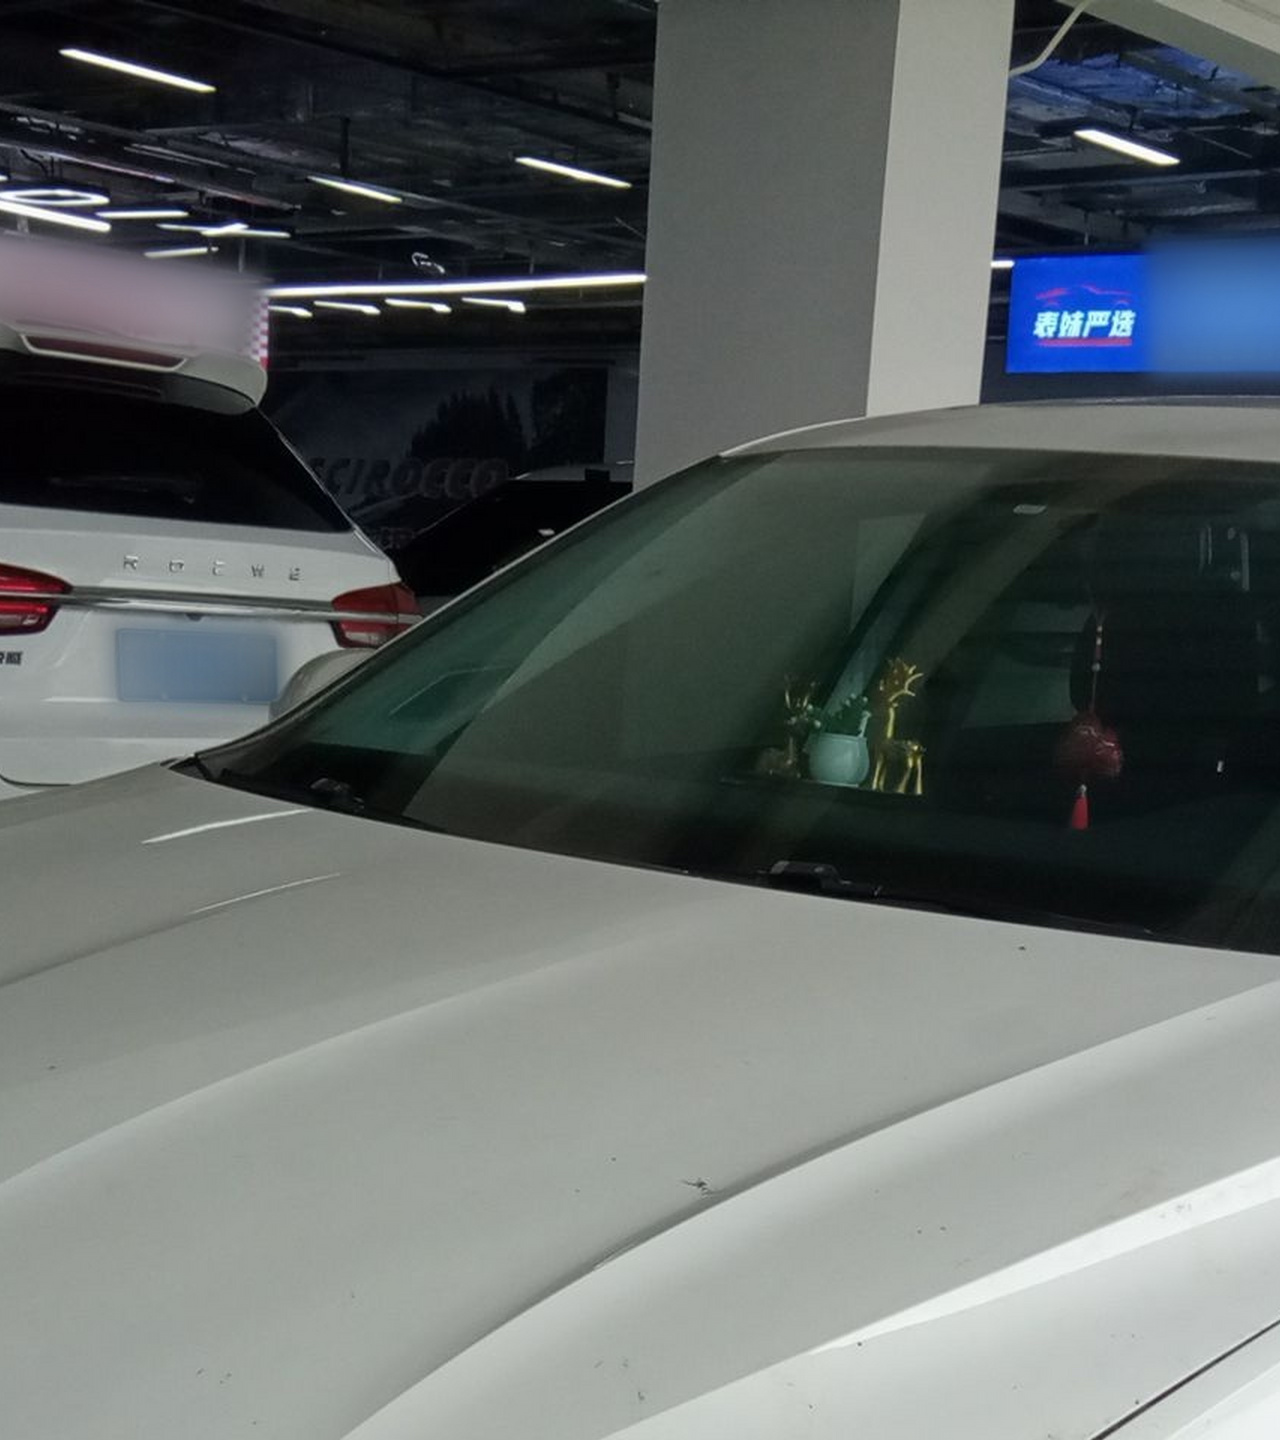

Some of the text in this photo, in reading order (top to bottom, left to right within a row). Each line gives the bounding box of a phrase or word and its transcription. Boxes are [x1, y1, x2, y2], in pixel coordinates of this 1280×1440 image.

[1032, 310, 1136, 338] 表妹严选
[123, 555, 302, 582] ROEWE
